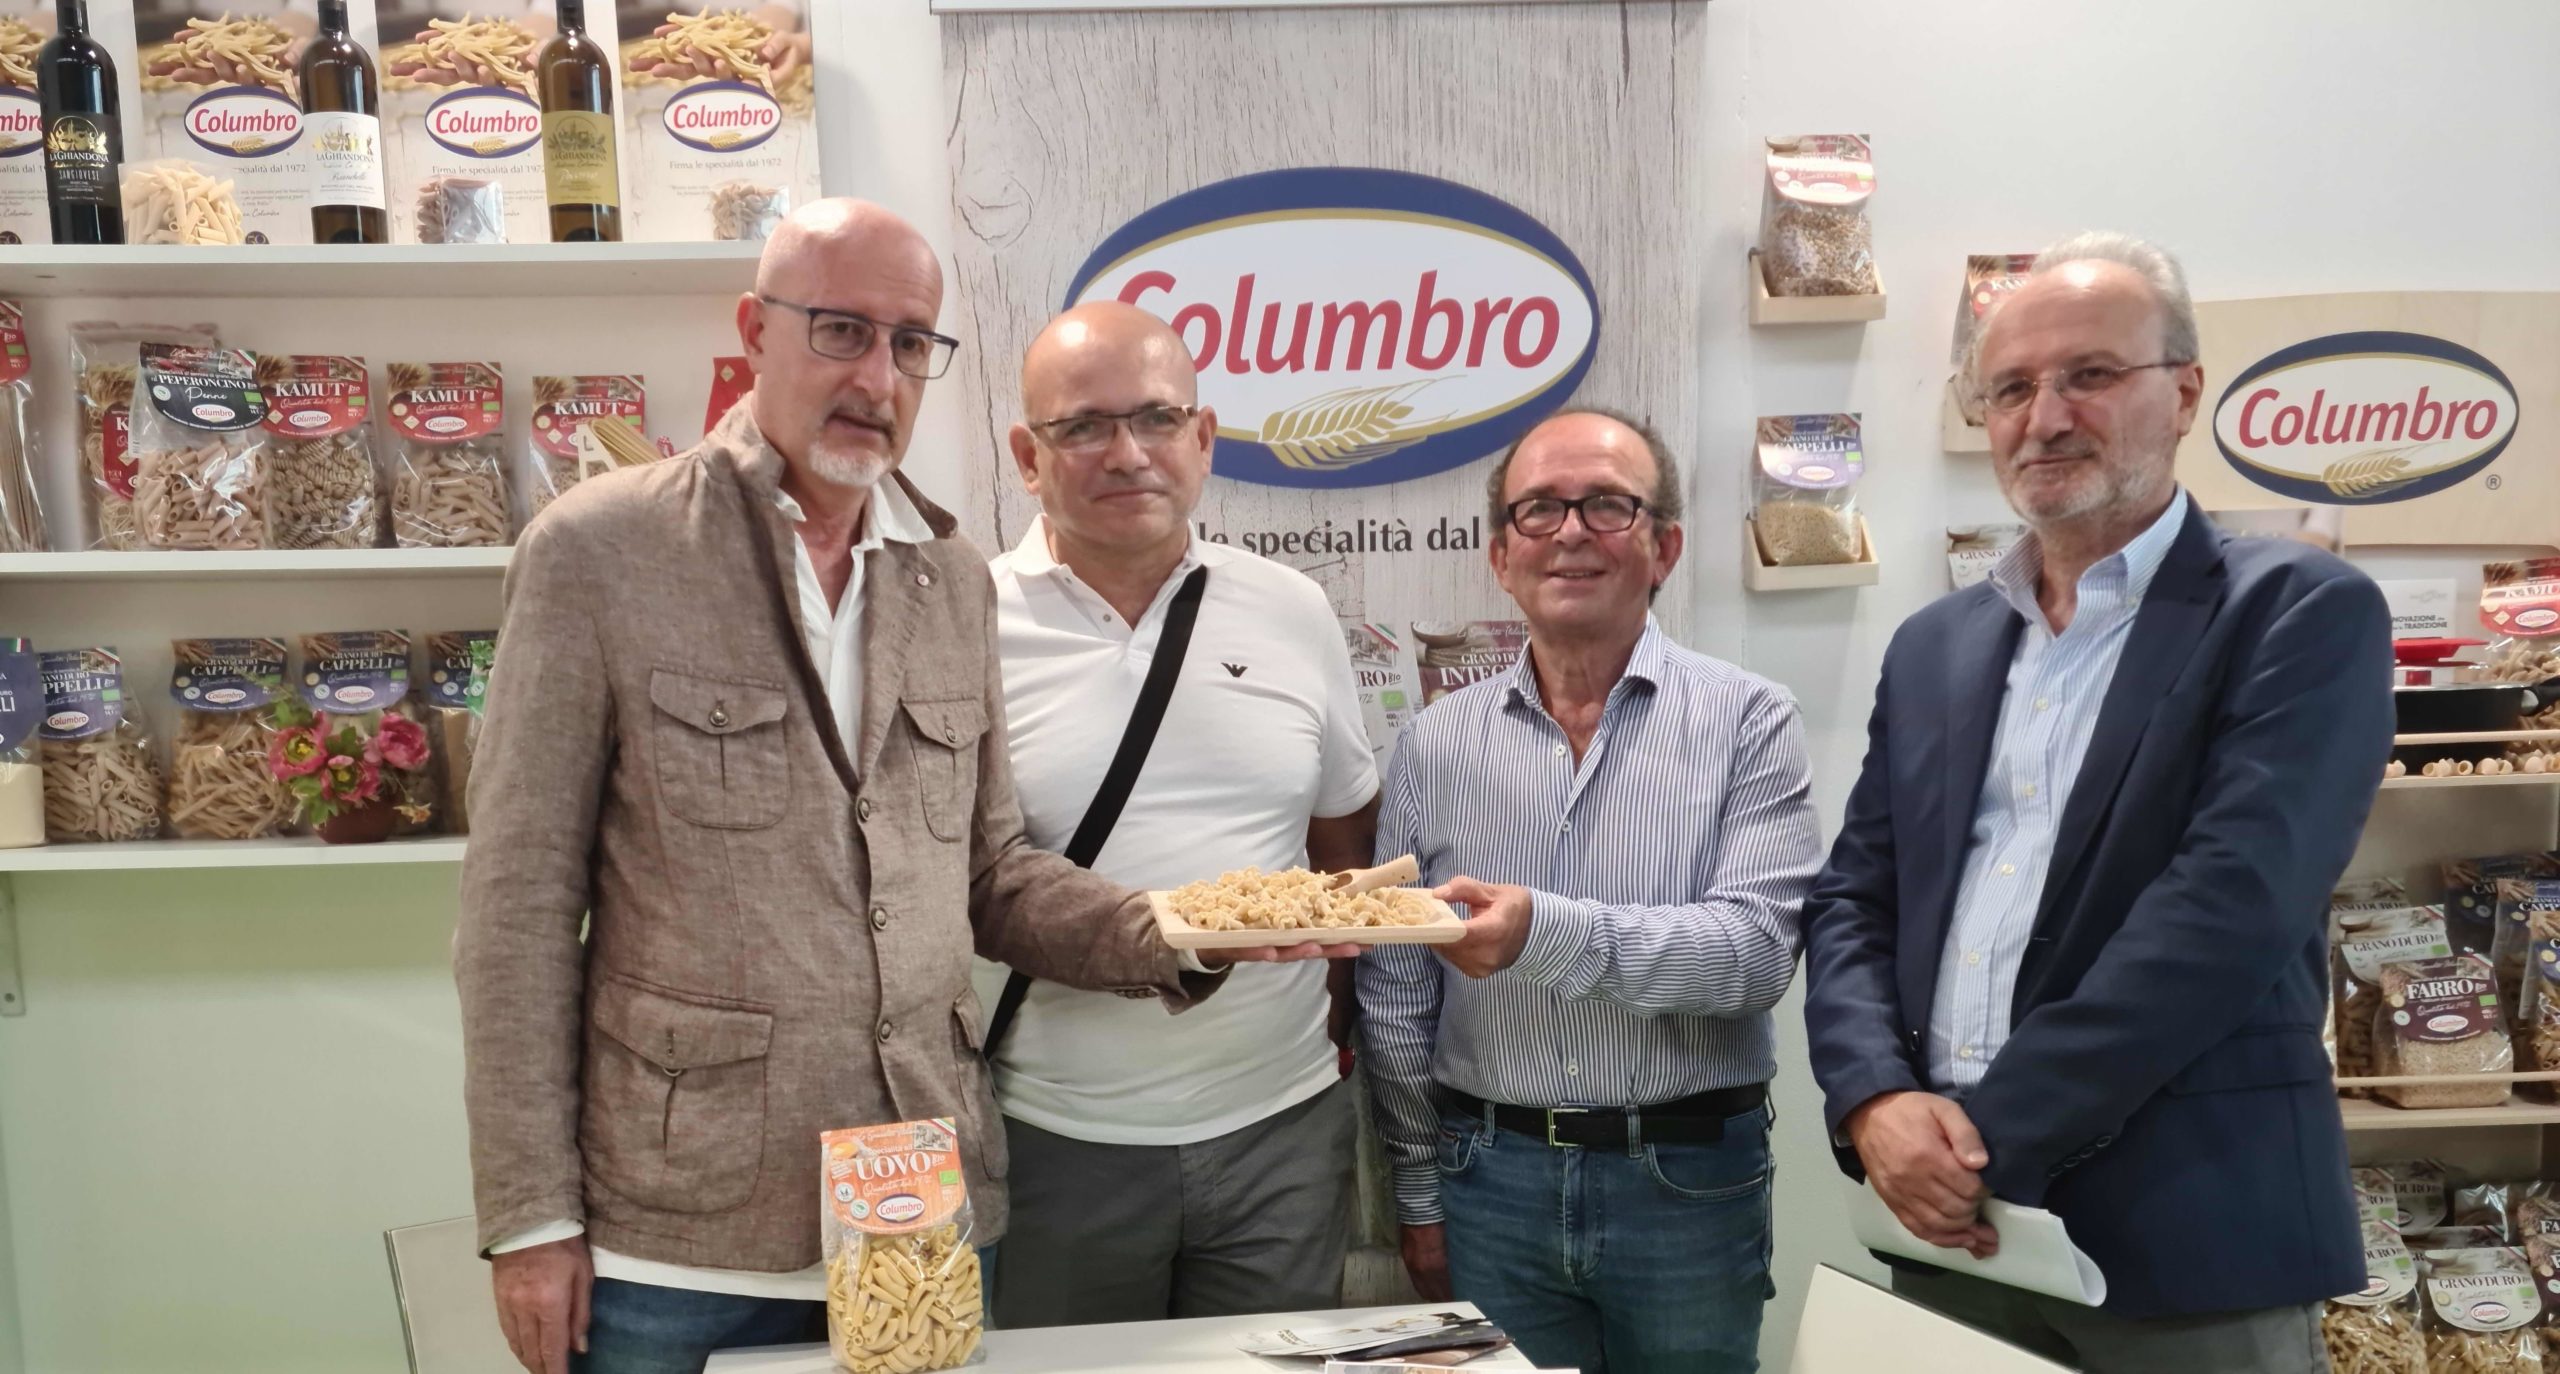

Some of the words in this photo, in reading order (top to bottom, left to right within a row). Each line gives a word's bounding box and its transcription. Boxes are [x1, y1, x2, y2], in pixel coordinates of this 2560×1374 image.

[194, 108, 297, 133] Columbro
[435, 109, 538, 134] Columbro
[673, 103, 773, 129] Columbro
[510, 164, 523, 173] dal
[669, 160, 693, 169] Firma
[695, 160, 704, 169] le
[705, 159, 744, 171] specialità
[746, 159, 758, 168] dal
[762, 158, 781, 167] 1972
[158, 374, 246, 389] PEPERONCINO
[185, 386, 228, 403] Penne
[275, 382, 345, 398] KAMUT
[411, 389, 480, 403] KAMUT
[195, 407, 233, 418] Columbro
[555, 401, 625, 416] KAMUT
[292, 414, 330, 424] Columbro
[2239, 385, 2498, 448] Columbro
[1243, 519, 1412, 557] specialità
[1427, 516, 1480, 551] dal
[320, 657, 392, 672] CAPPELLI
[1461, 653, 1501, 665] GRANO
[50, 715, 87, 727] Columbro
[2353, 939, 2396, 952] GRANO
[2398, 934, 2434, 946] DURO
[2406, 979, 2474, 999] FARRO
[855, 1151, 931, 1181] UOVO
[880, 1203, 923, 1216] Columbro
[2440, 1276, 2483, 1289] GRANO
[2485, 1274, 2521, 1287] DURO
